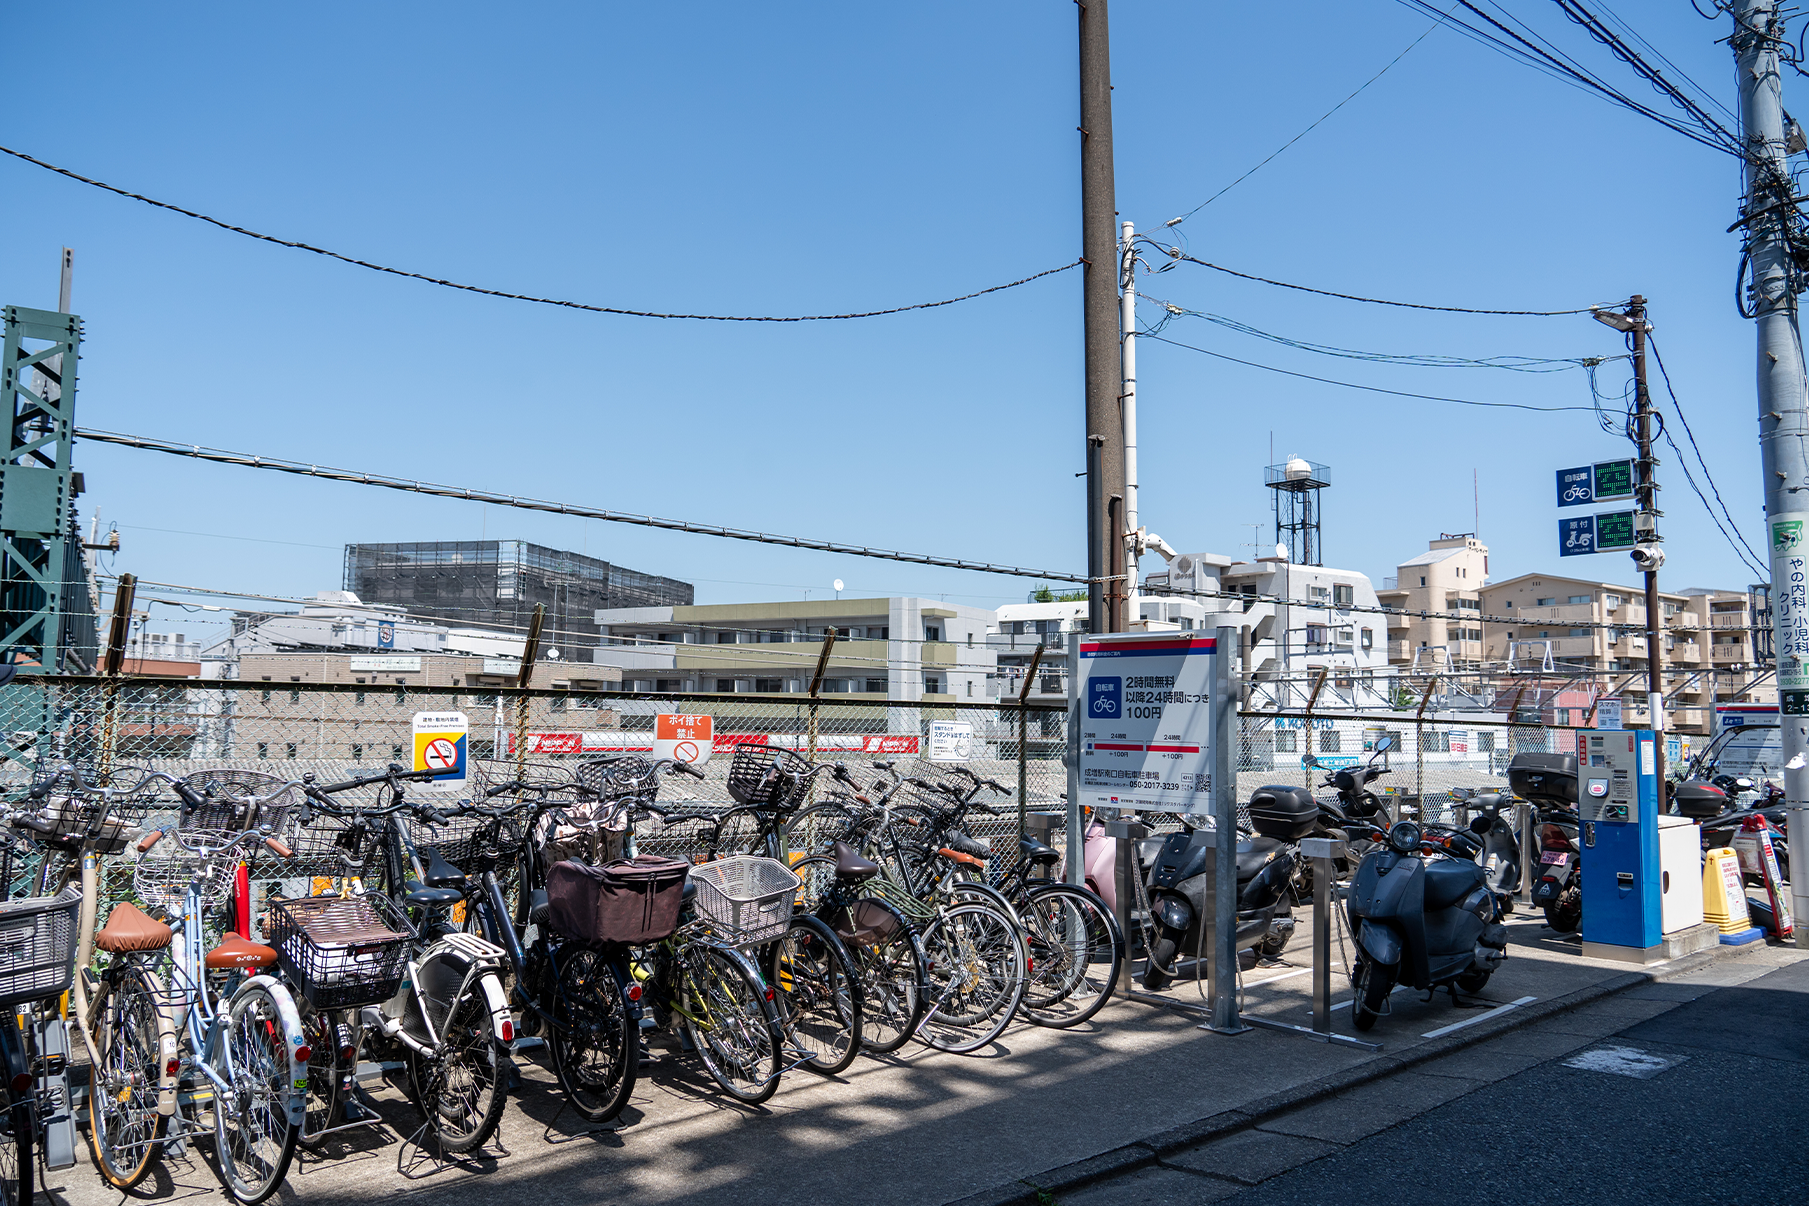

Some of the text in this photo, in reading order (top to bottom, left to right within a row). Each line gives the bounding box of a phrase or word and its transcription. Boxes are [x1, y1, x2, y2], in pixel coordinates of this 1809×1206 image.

[1564, 472, 1588, 482] 自転車
[1570, 520, 1588, 529] 原付
[1779, 591, 1793, 655] クリニック
[1125, 676, 1175, 689] 2時間無料
[1096, 684, 1115, 692] 自転車
[1125, 691, 1210, 704] 以降24時間につき
[1127, 707, 1162, 719] 100円
[668, 716, 703, 726] ポイ捨て
[676, 728, 696, 739] 禁止
[1110, 732, 1127, 740] 24時間
[1084, 768, 1160, 781] 成増駅南口自転車駐車場
[1129, 780, 1179, 790] 050-2017-3239
